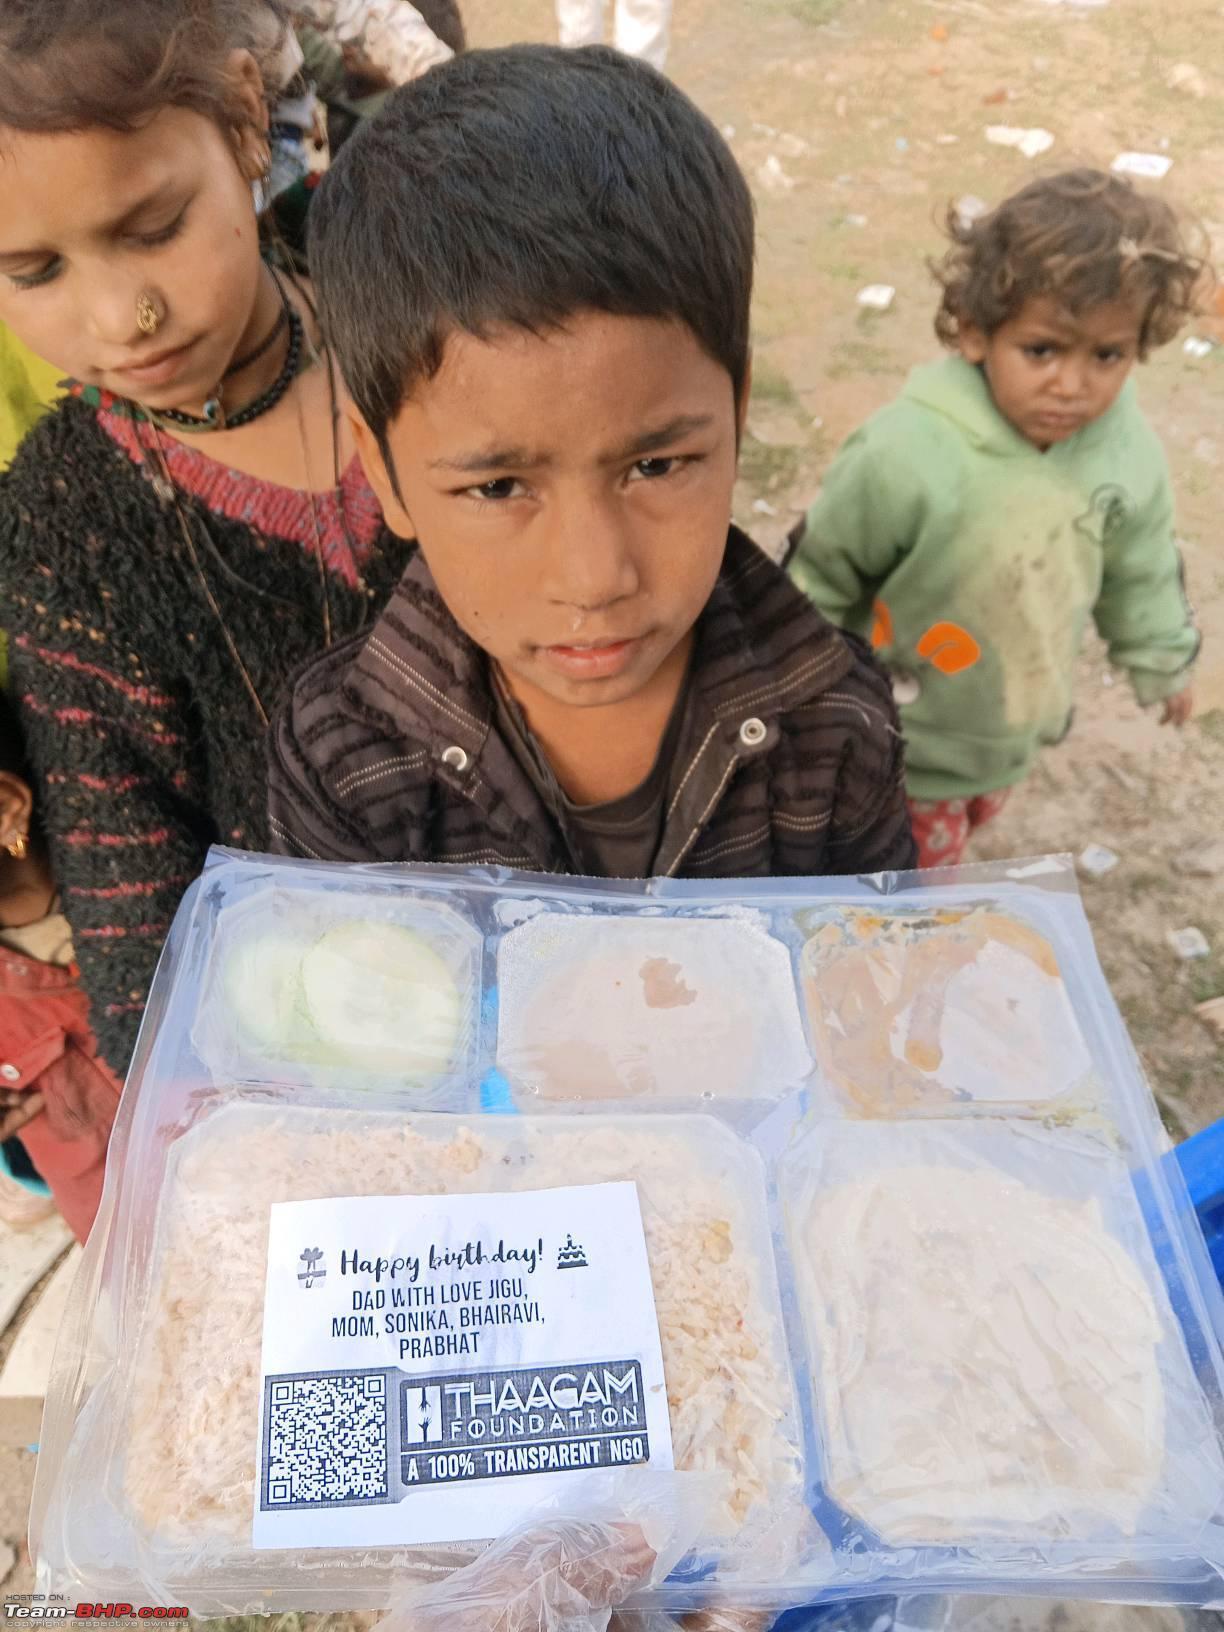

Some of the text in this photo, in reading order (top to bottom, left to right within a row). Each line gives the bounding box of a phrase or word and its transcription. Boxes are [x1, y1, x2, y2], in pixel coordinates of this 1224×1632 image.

[341, 1238, 544, 1282] Happy birthday!
[352, 1278, 529, 1311] DAD WITH LOVE JIGU,
[331, 1302, 546, 1339] MOM, SONIKA, BHAIRAVI,
[399, 1332, 481, 1360] PRABHAT
[444, 1366, 639, 1420] THAAGAM
[450, 1405, 640, 1441] FOUNDATION
[406, 1436, 644, 1482] A 100% TRANSPARENT NGO
